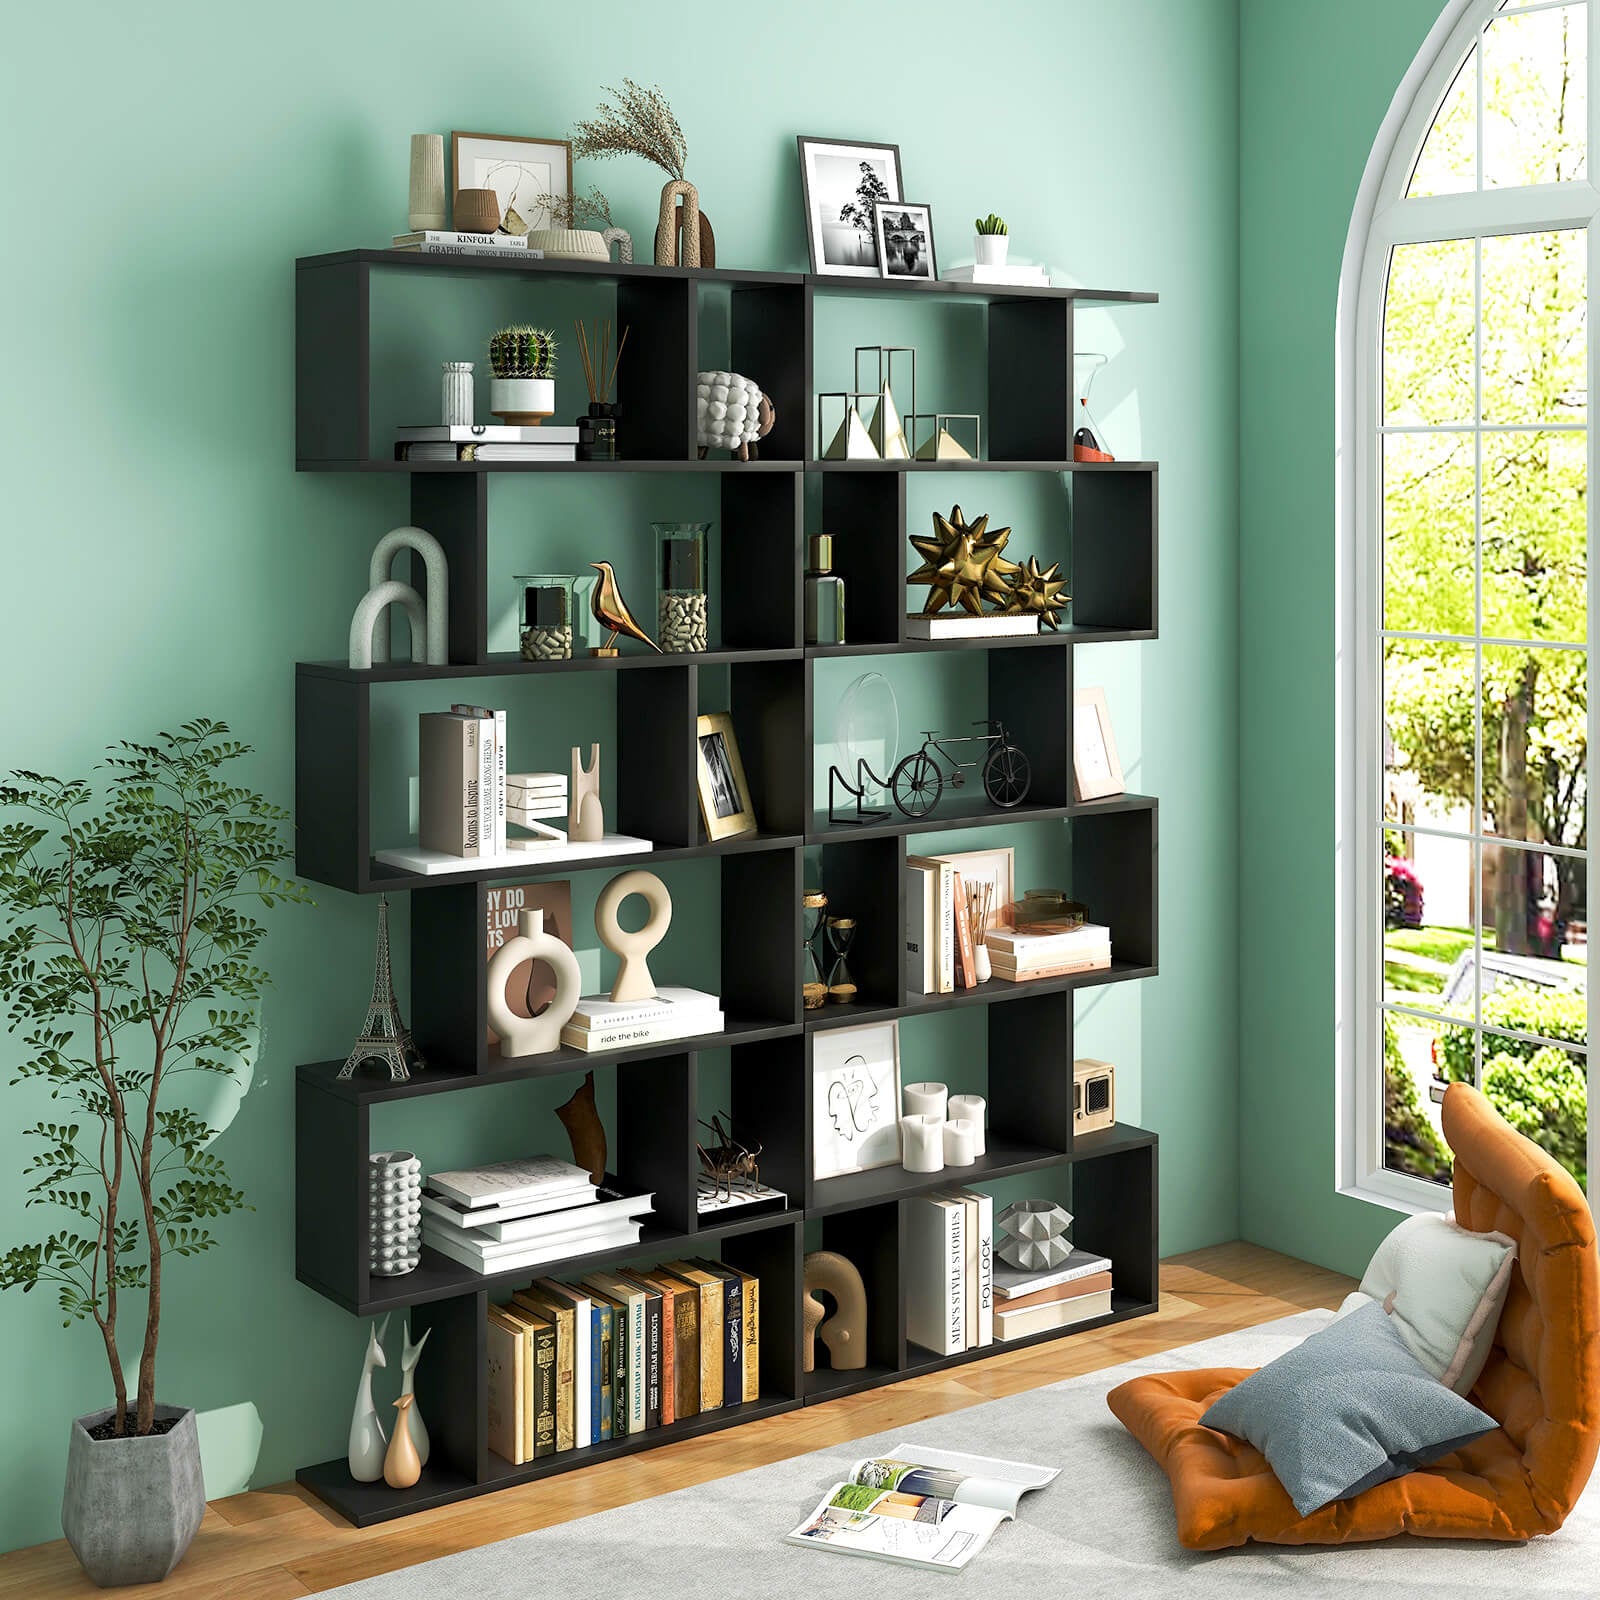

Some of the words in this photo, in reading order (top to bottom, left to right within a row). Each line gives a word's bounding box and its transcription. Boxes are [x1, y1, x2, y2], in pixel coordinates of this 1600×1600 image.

[428, 245, 465, 256] GRAPHIC
[457, 234, 496, 245] KINFOLK
[483, 739, 492, 764] FRIENDS
[483, 764, 492, 786] AMONG
[498, 775, 504, 788] BY
[464, 780, 479, 808] Inspire
[483, 788, 492, 805] HOME
[465, 810, 477, 820] to
[483, 805, 492, 823] YOUR
[464, 821, 478, 849] Rooms
[483, 823, 492, 840] MAKE
[486, 890, 501, 911] HY
[505, 888, 525, 909] DO
[495, 909, 519, 929] LOV
[600, 1034, 617, 1044] ride
[618, 1031, 631, 1042] the
[633, 1029, 650, 1039] bike
[952, 1211, 960, 1264] STORIES
[982, 1236, 991, 1309] POLLOCK
[952, 1266, 960, 1305] STYLE
[651, 1313, 659, 1352] КРЕПОСТЬ
[952, 1307, 960, 1344] MEN'S
